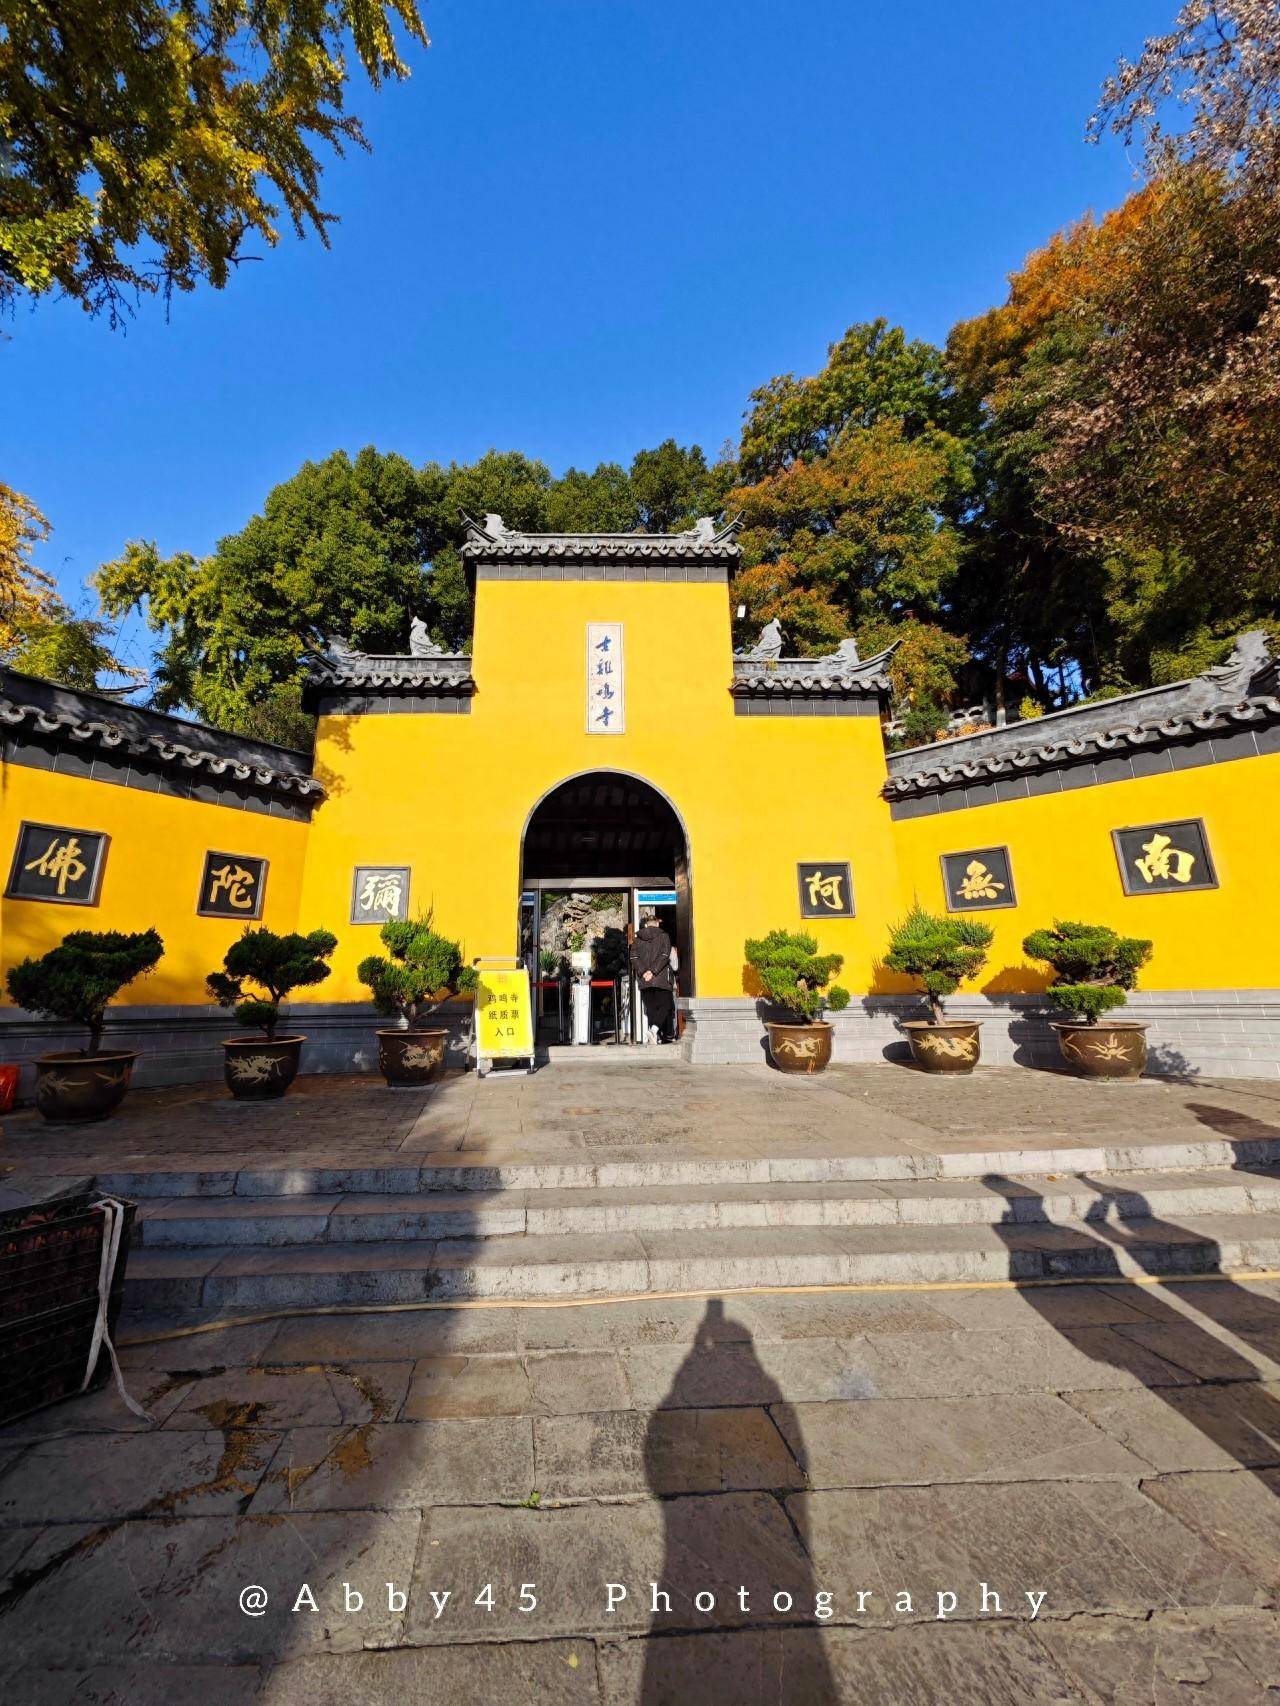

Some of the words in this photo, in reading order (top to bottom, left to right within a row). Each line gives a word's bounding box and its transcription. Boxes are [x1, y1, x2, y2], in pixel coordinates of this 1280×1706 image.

[24, 837, 87, 895] 佛
[1134, 833, 1195, 883] 南
[210, 865, 255, 909] 陀
[804, 871, 844, 910] 阿
[956, 859, 1006, 899] 無
[487, 993, 519, 1004] 鸡鸣寺
[488, 1009, 520, 1020] 纸质票
[495, 1027, 515, 1037] 入口
